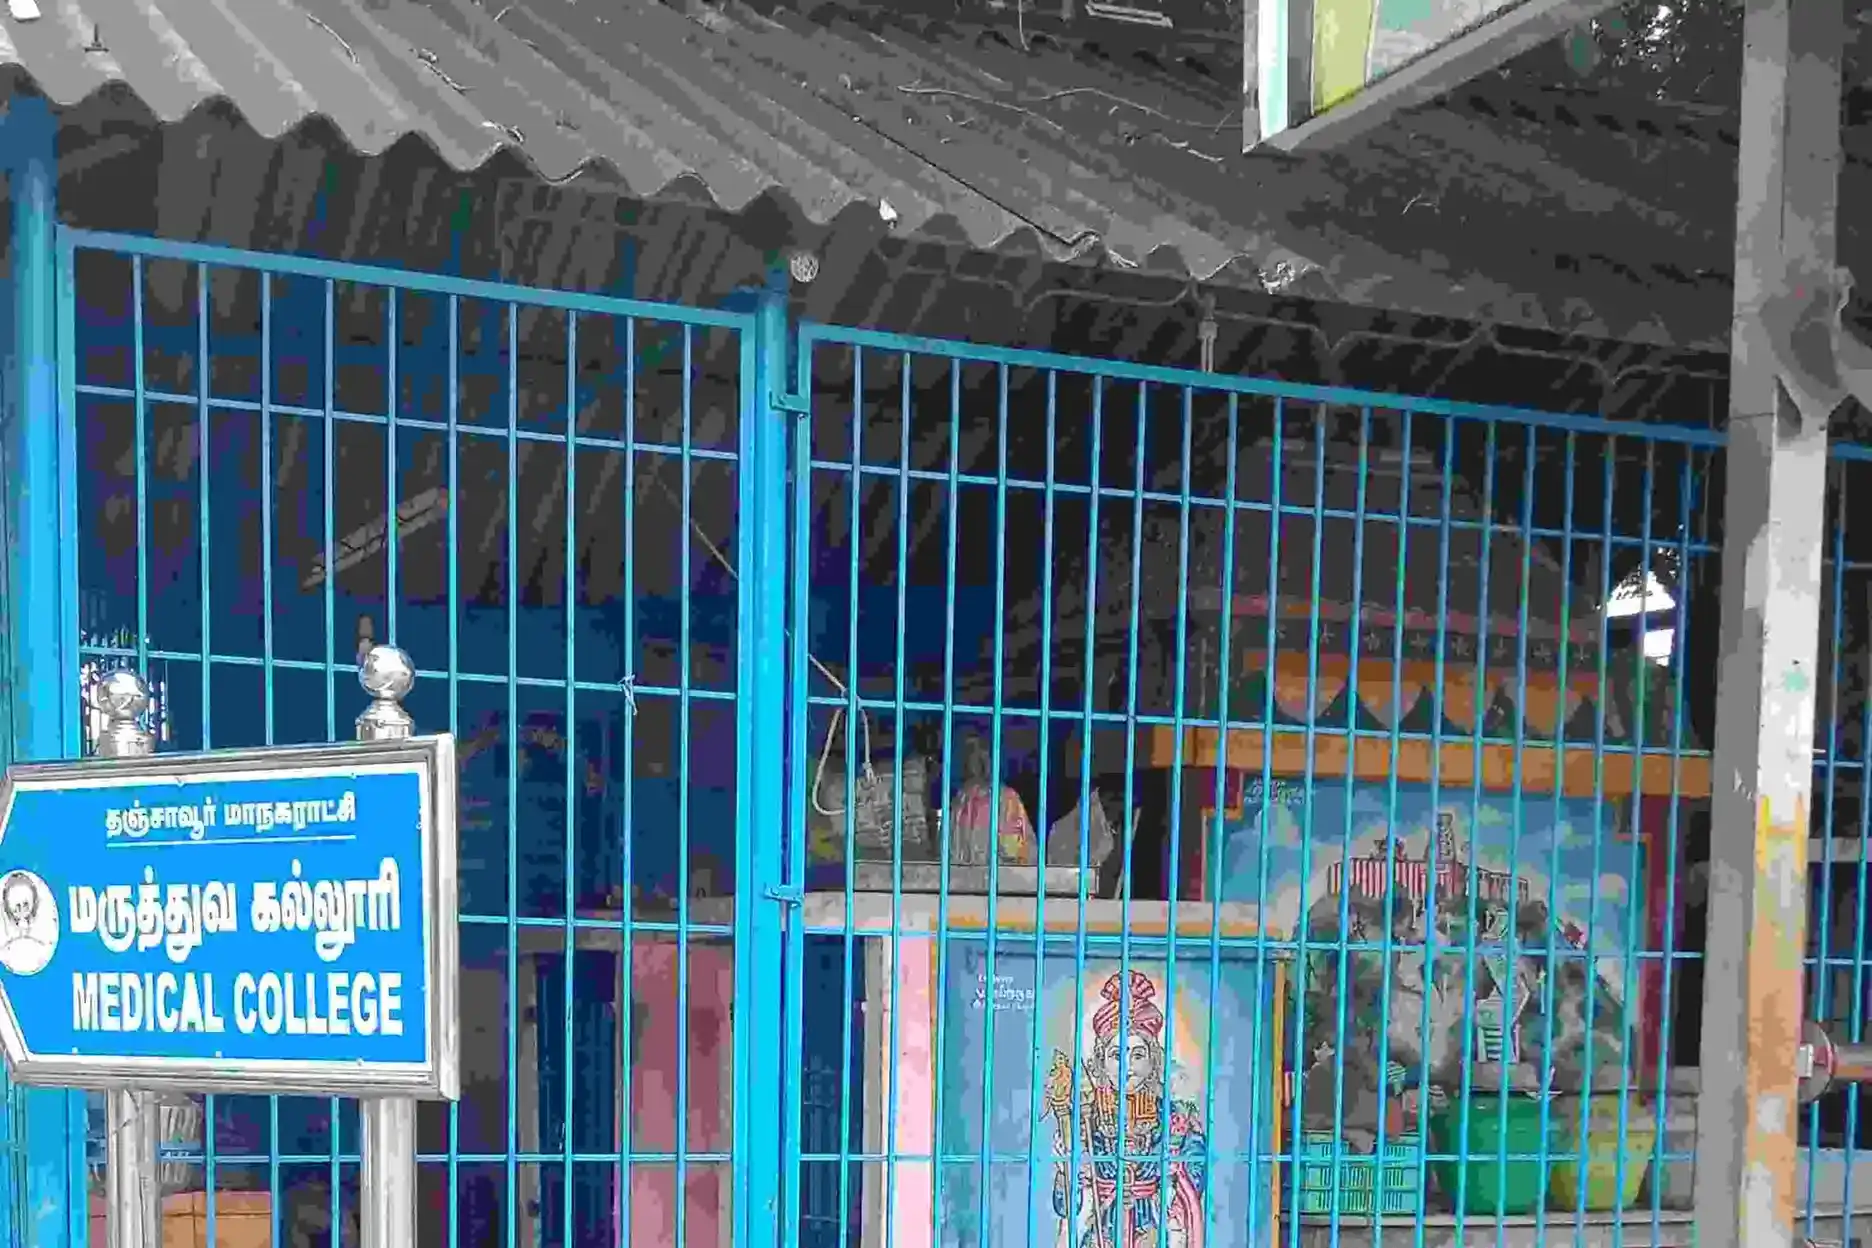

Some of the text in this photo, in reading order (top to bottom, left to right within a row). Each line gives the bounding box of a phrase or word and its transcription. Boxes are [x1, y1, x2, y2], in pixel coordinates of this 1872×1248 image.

[105, 790, 356, 841] தஞ்சாவூர் மாநகராட்சி
[68, 857, 401, 963] மருத்துவ கல்லூரி
[72, 971, 404, 1036] MEDICAL COLLEGE
